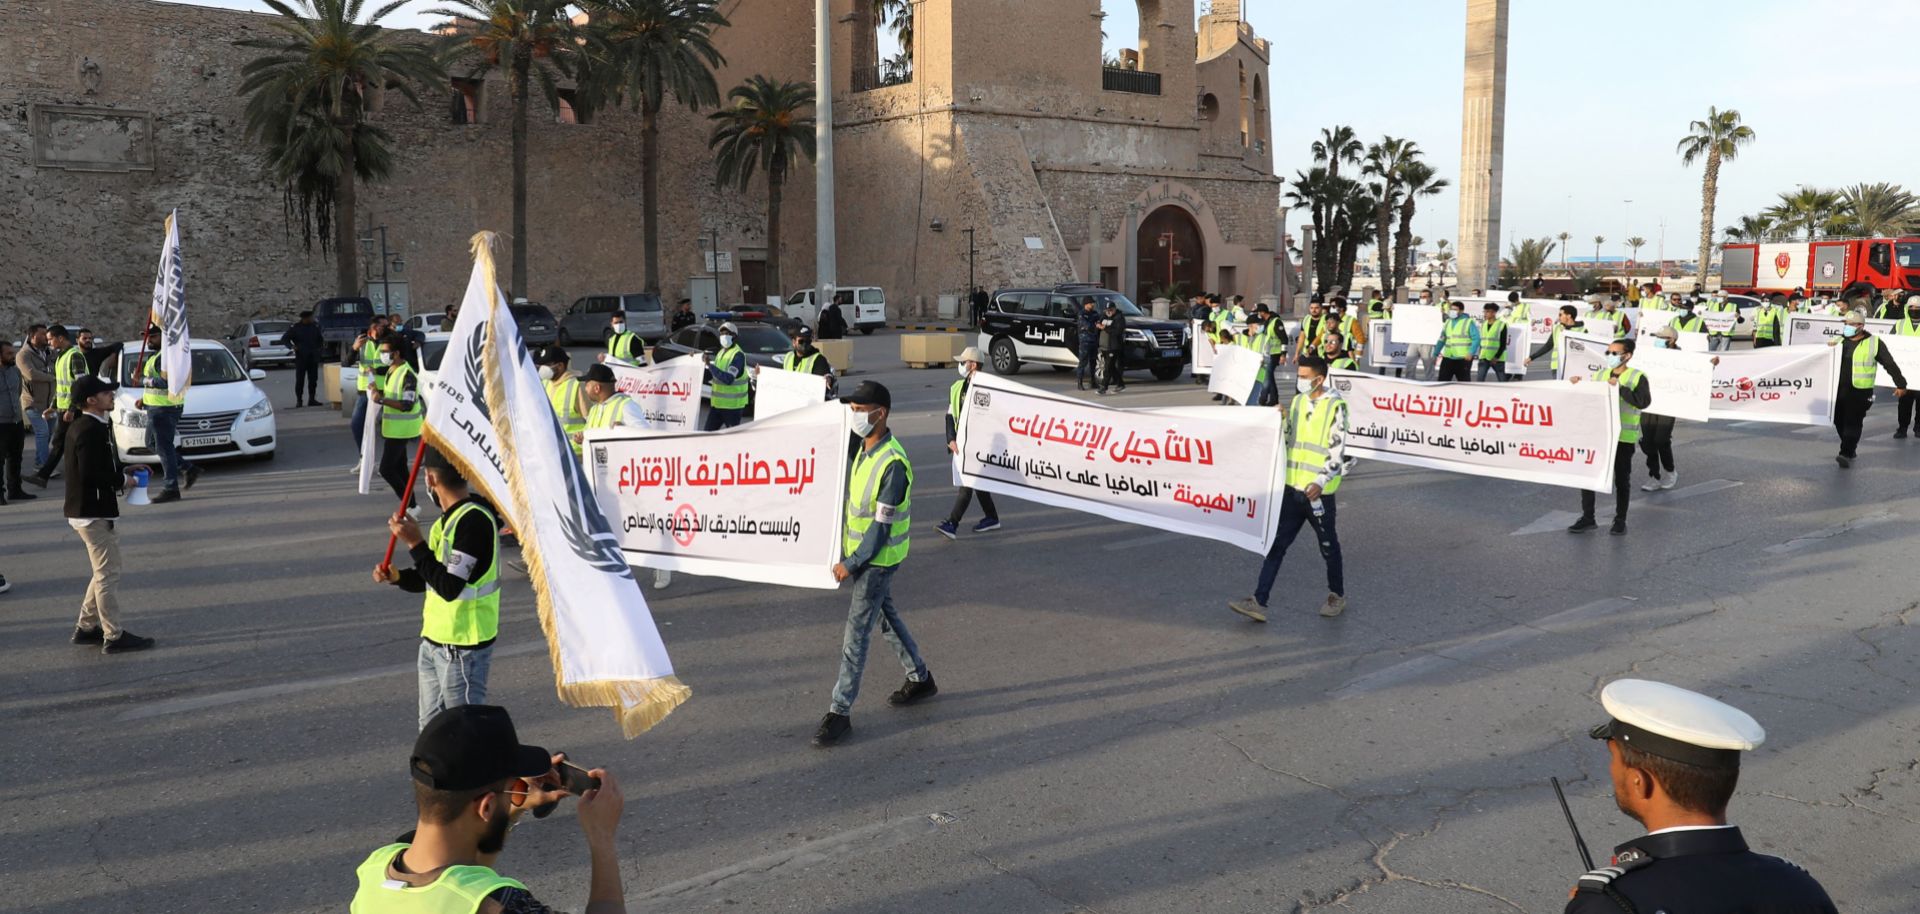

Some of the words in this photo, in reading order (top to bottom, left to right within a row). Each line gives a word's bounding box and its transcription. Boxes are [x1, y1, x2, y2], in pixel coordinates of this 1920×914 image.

[438, 381, 465, 403] #DB
[1757, 377, 1802, 390] وطنية
[1804, 377, 1812, 388] لا
[1728, 386, 1756, 402] أجل
[1760, 391, 1781, 401] من
[1372, 393, 1463, 427] الإنتخابات
[1538, 405, 1553, 427] لا
[1008, 414, 1113, 462] الإنتخابات
[1347, 422, 1388, 440] الشعب
[1390, 427, 1424, 446] اختيار
[1427, 434, 1456, 450] على
[1195, 439, 1214, 466] لا
[1460, 436, 1504, 455] المافيا
[774, 447, 816, 495] نريد
[975, 449, 1020, 471] الشعب
[1025, 458, 1062, 480] اختيار
[617, 455, 682, 502] الإقتراع
[684, 452, 772, 496] صناديق
[1065, 469, 1101, 487] على
[1105, 472, 1159, 499] المافيا
[665, 512, 708, 537] الذخيرة
[709, 514, 757, 539] صناديق
[759, 516, 801, 543] وليست
